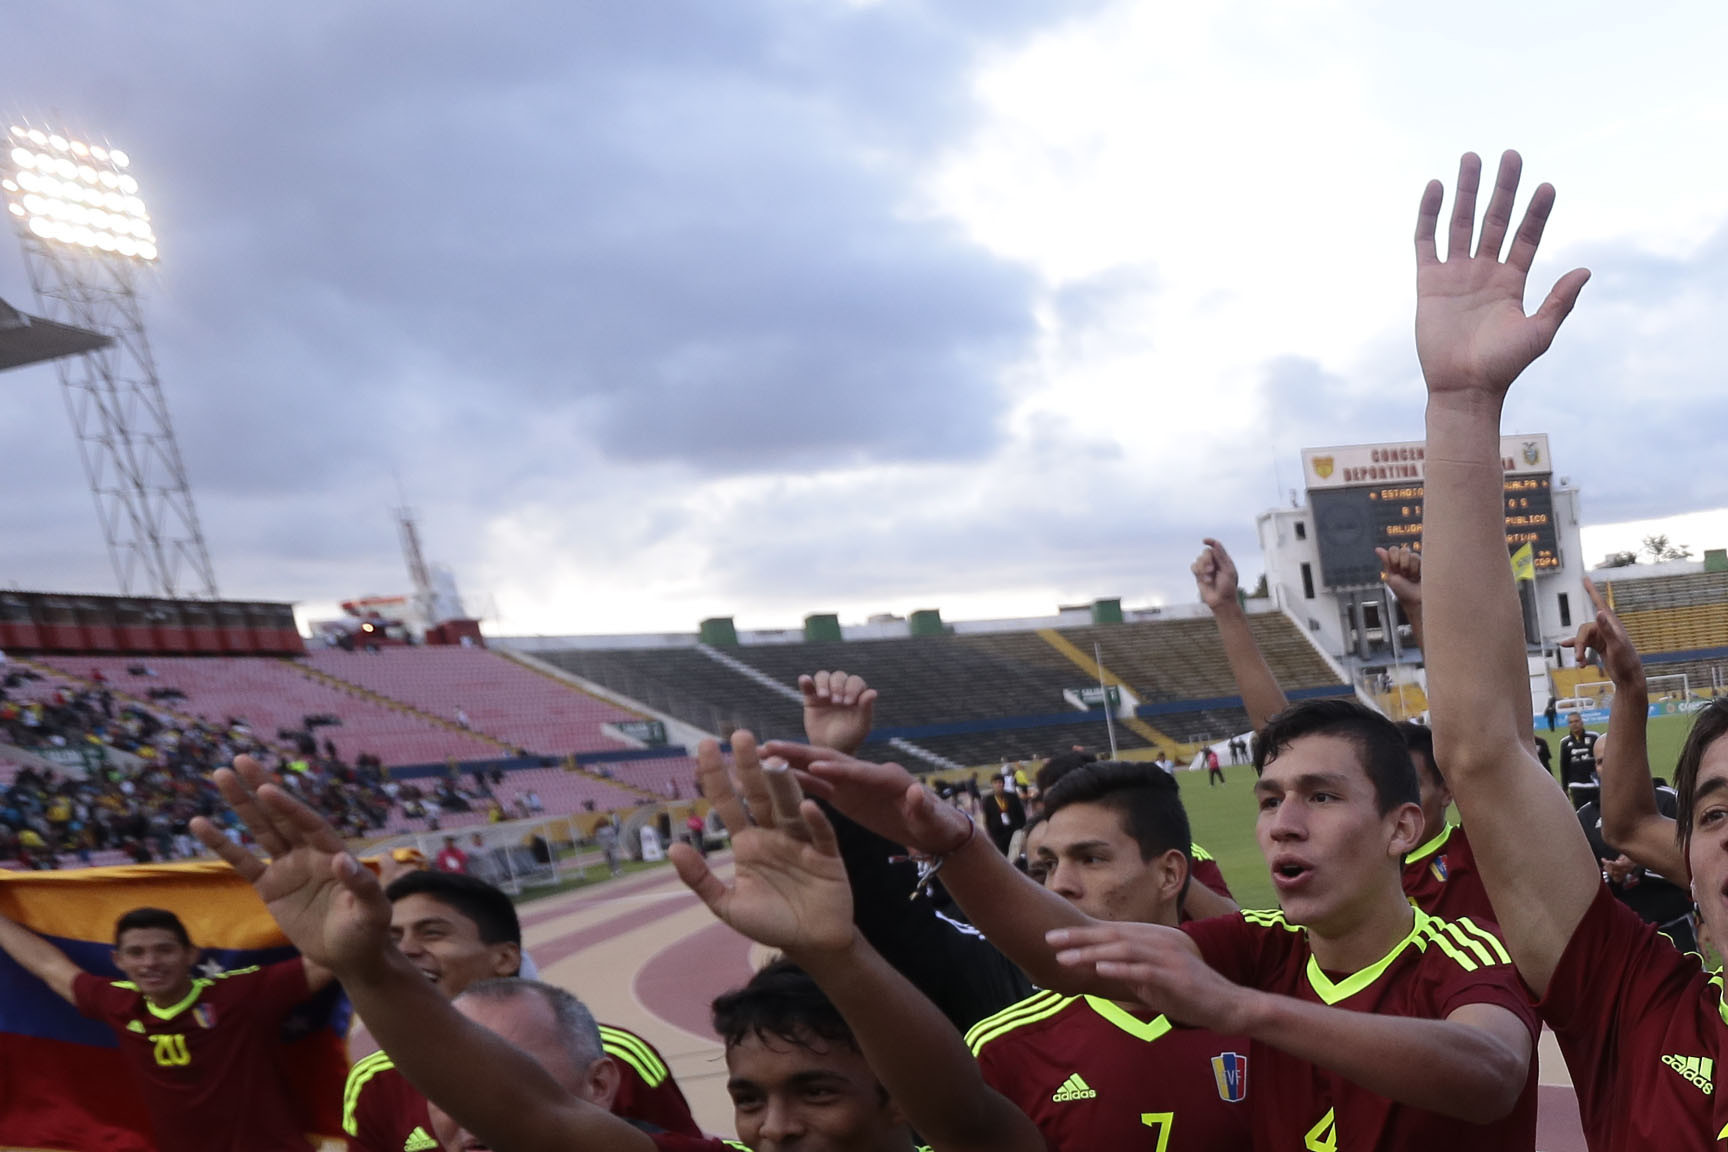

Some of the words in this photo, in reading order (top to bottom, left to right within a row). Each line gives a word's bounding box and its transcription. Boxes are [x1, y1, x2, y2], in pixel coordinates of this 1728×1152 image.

[1343, 463, 1418, 481] DEPORTIVA
[1505, 514, 1548, 526] PUBLICO
[148, 1034, 191, 1066] 20
[1661, 1055, 1713, 1095] adidas
[1052, 1089, 1096, 1102] adidas
